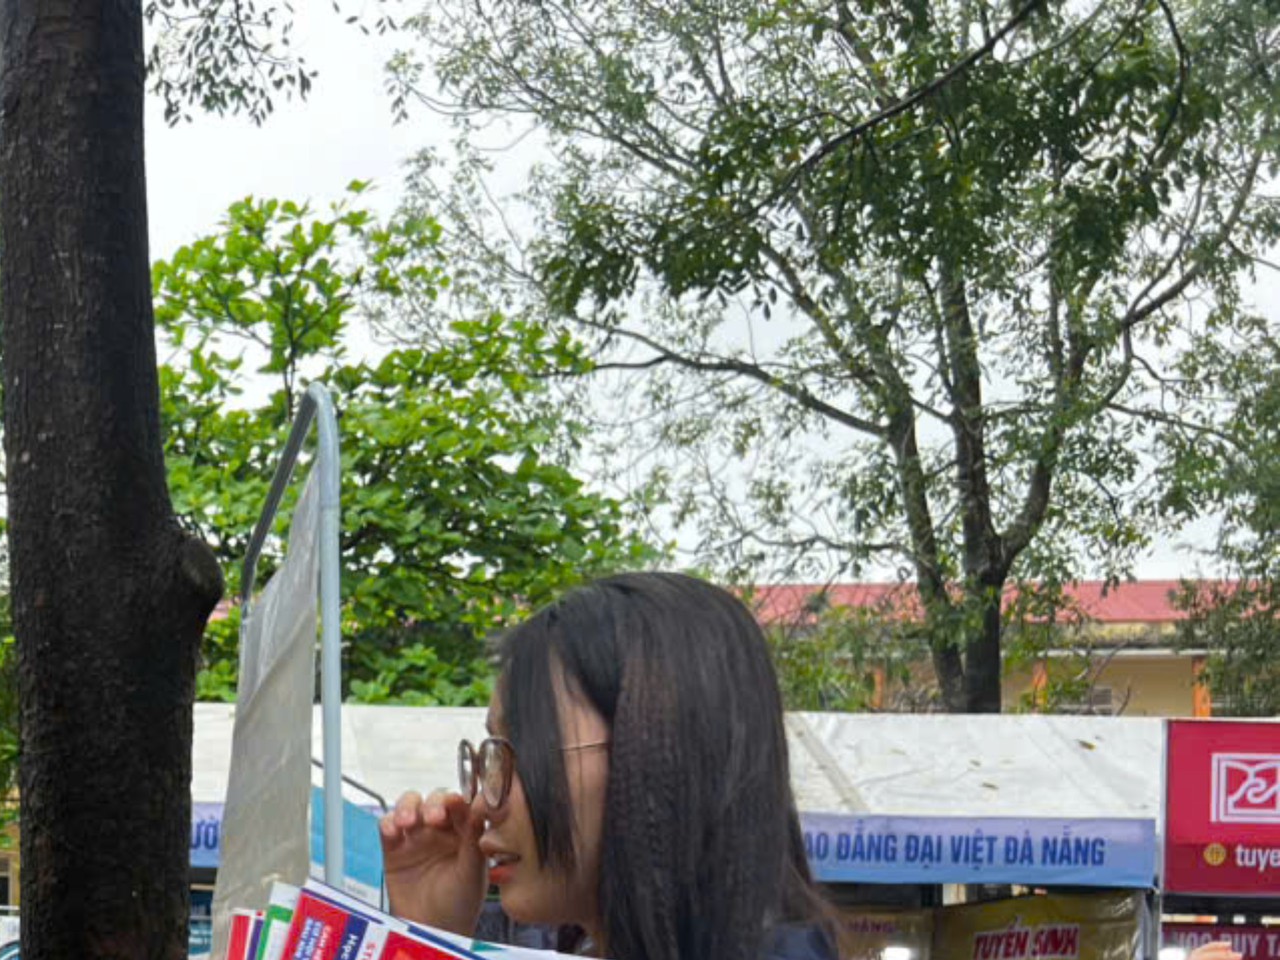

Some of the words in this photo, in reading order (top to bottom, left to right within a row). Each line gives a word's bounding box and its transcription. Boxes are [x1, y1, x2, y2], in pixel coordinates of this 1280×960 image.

[803, 831, 829, 860] AO
[904, 833, 943, 869] ĐẠI
[949, 827, 998, 871] VIỆT
[1004, 829, 1036, 865] ĐÀ
